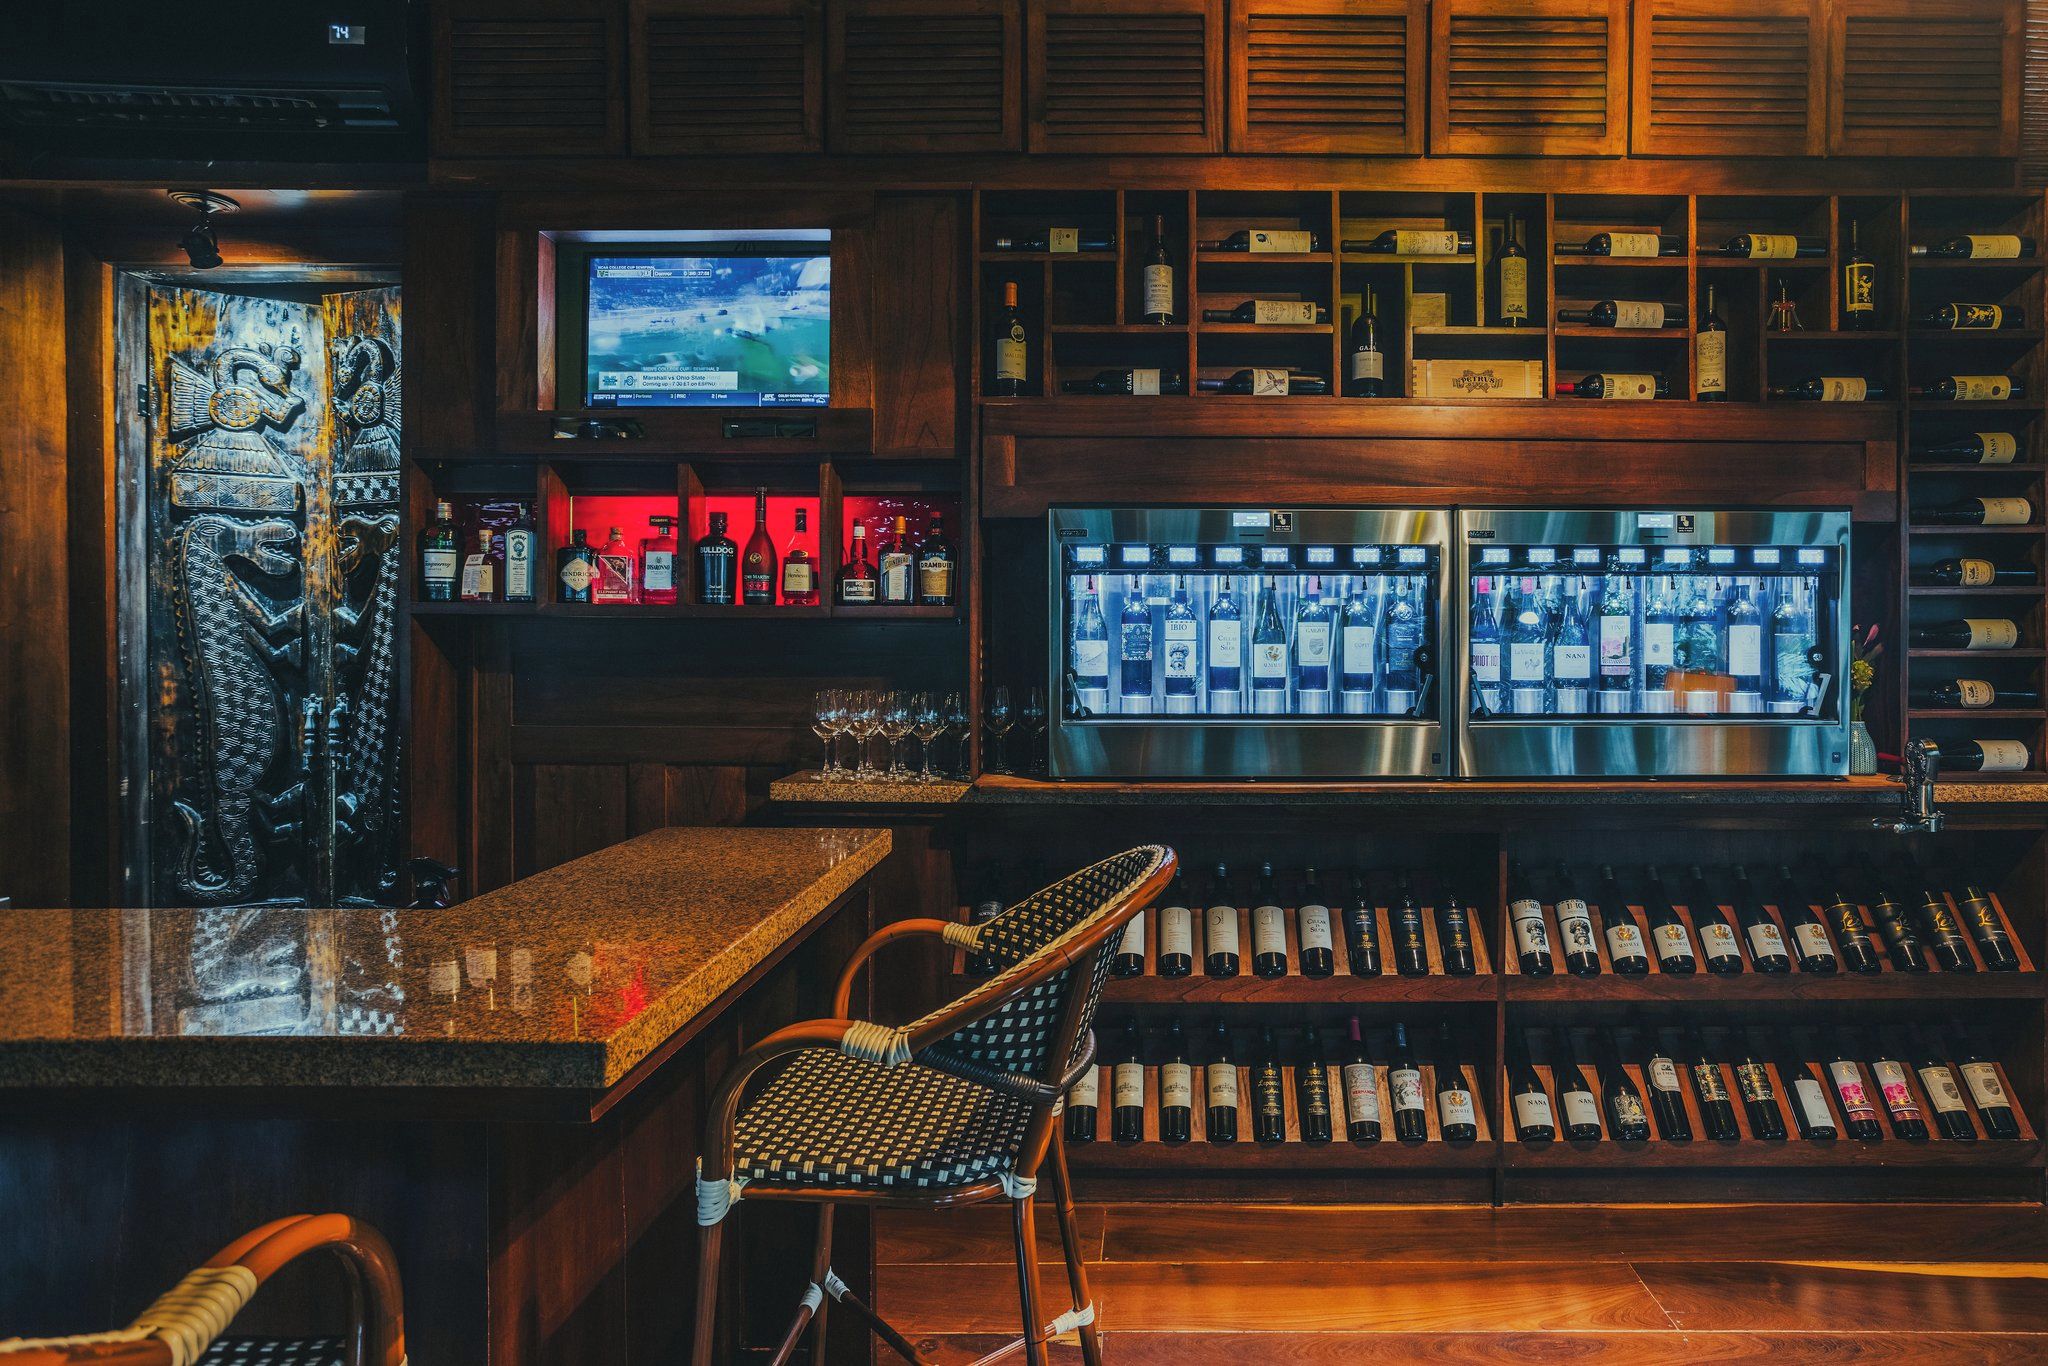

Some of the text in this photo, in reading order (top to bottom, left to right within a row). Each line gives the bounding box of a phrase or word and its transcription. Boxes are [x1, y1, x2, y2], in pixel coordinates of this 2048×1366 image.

[331, 25, 349, 39] 74
[1990, 438, 1998, 459] NANA
[700, 546, 734, 554] BULLDOG
[1472, 654, 1489, 667] PINOT
